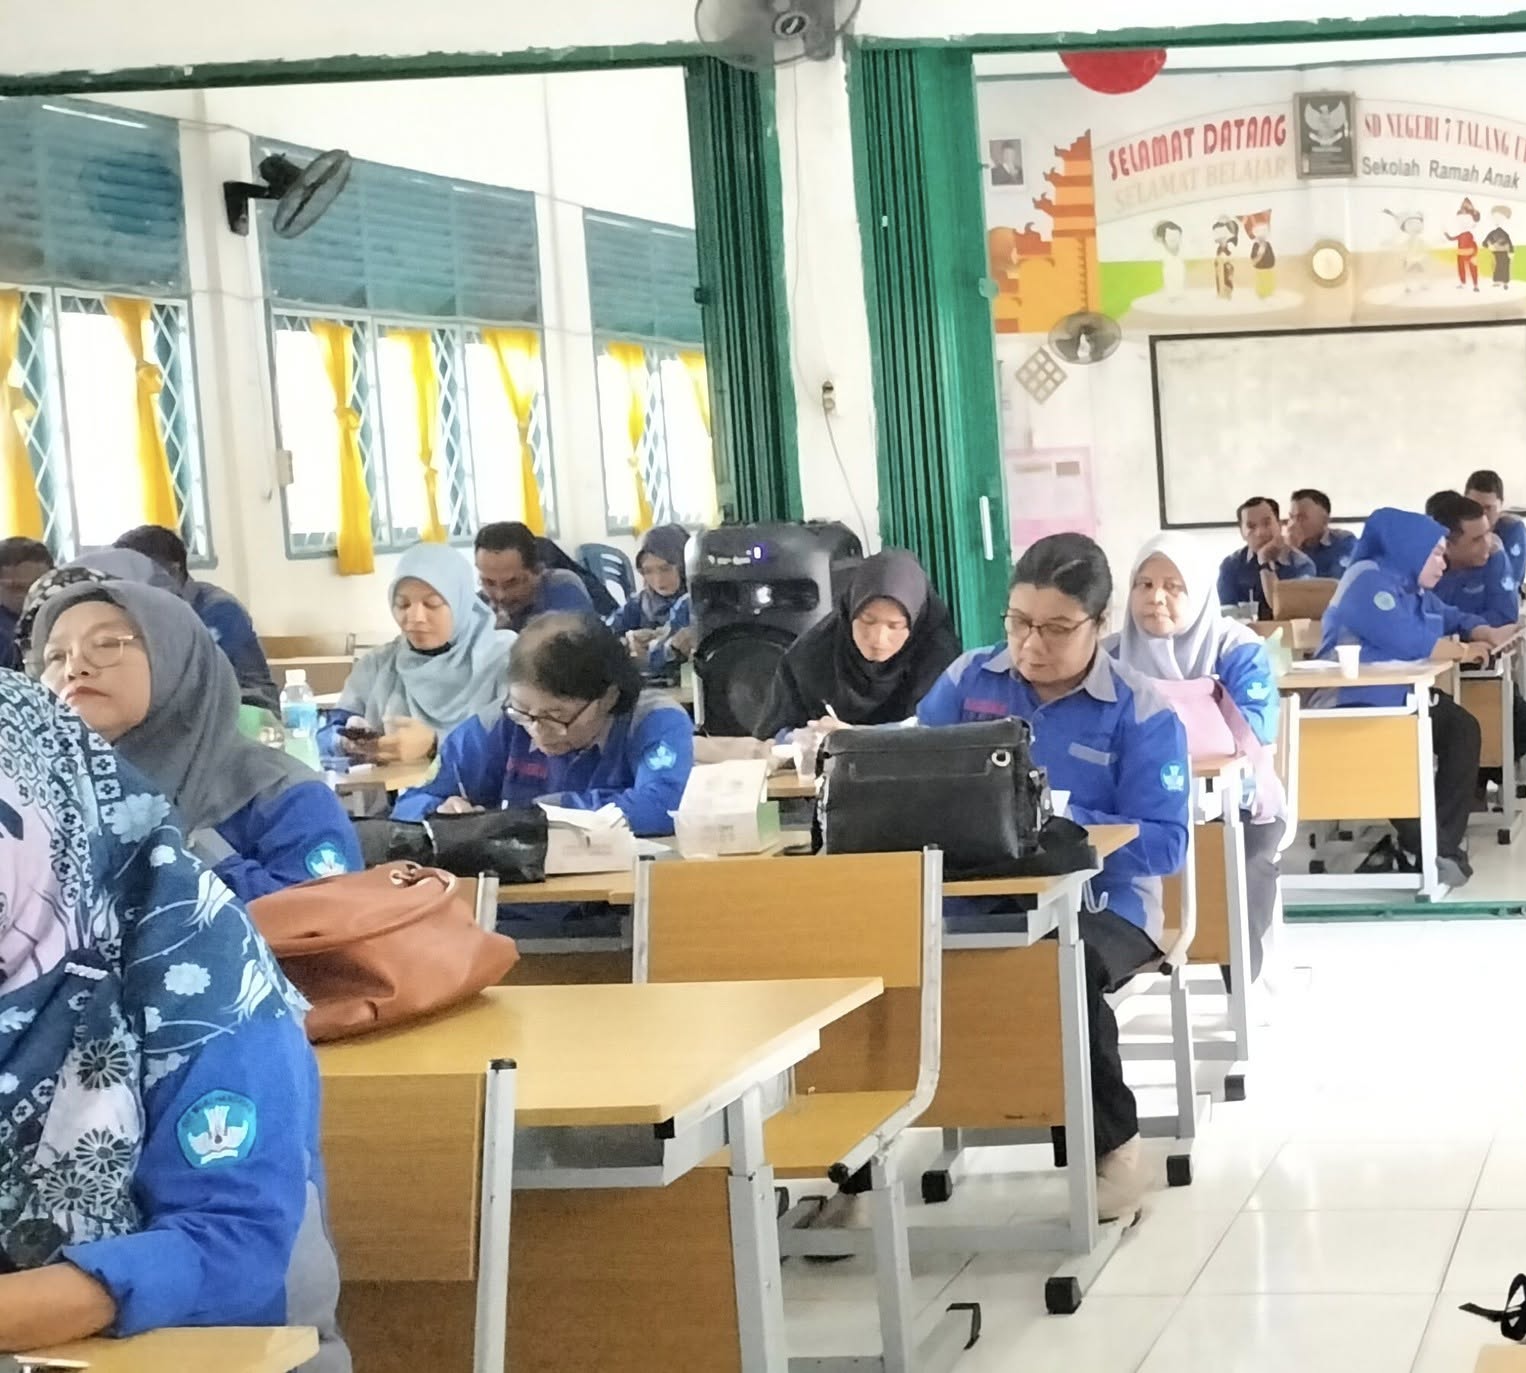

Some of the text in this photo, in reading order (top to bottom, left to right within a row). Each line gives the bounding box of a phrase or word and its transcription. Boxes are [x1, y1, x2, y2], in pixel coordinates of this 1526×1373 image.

[1108, 114, 1287, 181] SELAMAT DATANG
[1387, 112, 1440, 142] NEGERI
[1456, 119, 1510, 156] TALANG
[1114, 154, 1289, 213] SELAMAT BELAJAR
[1362, 155, 1521, 190] Sekolah Ramah Anak
